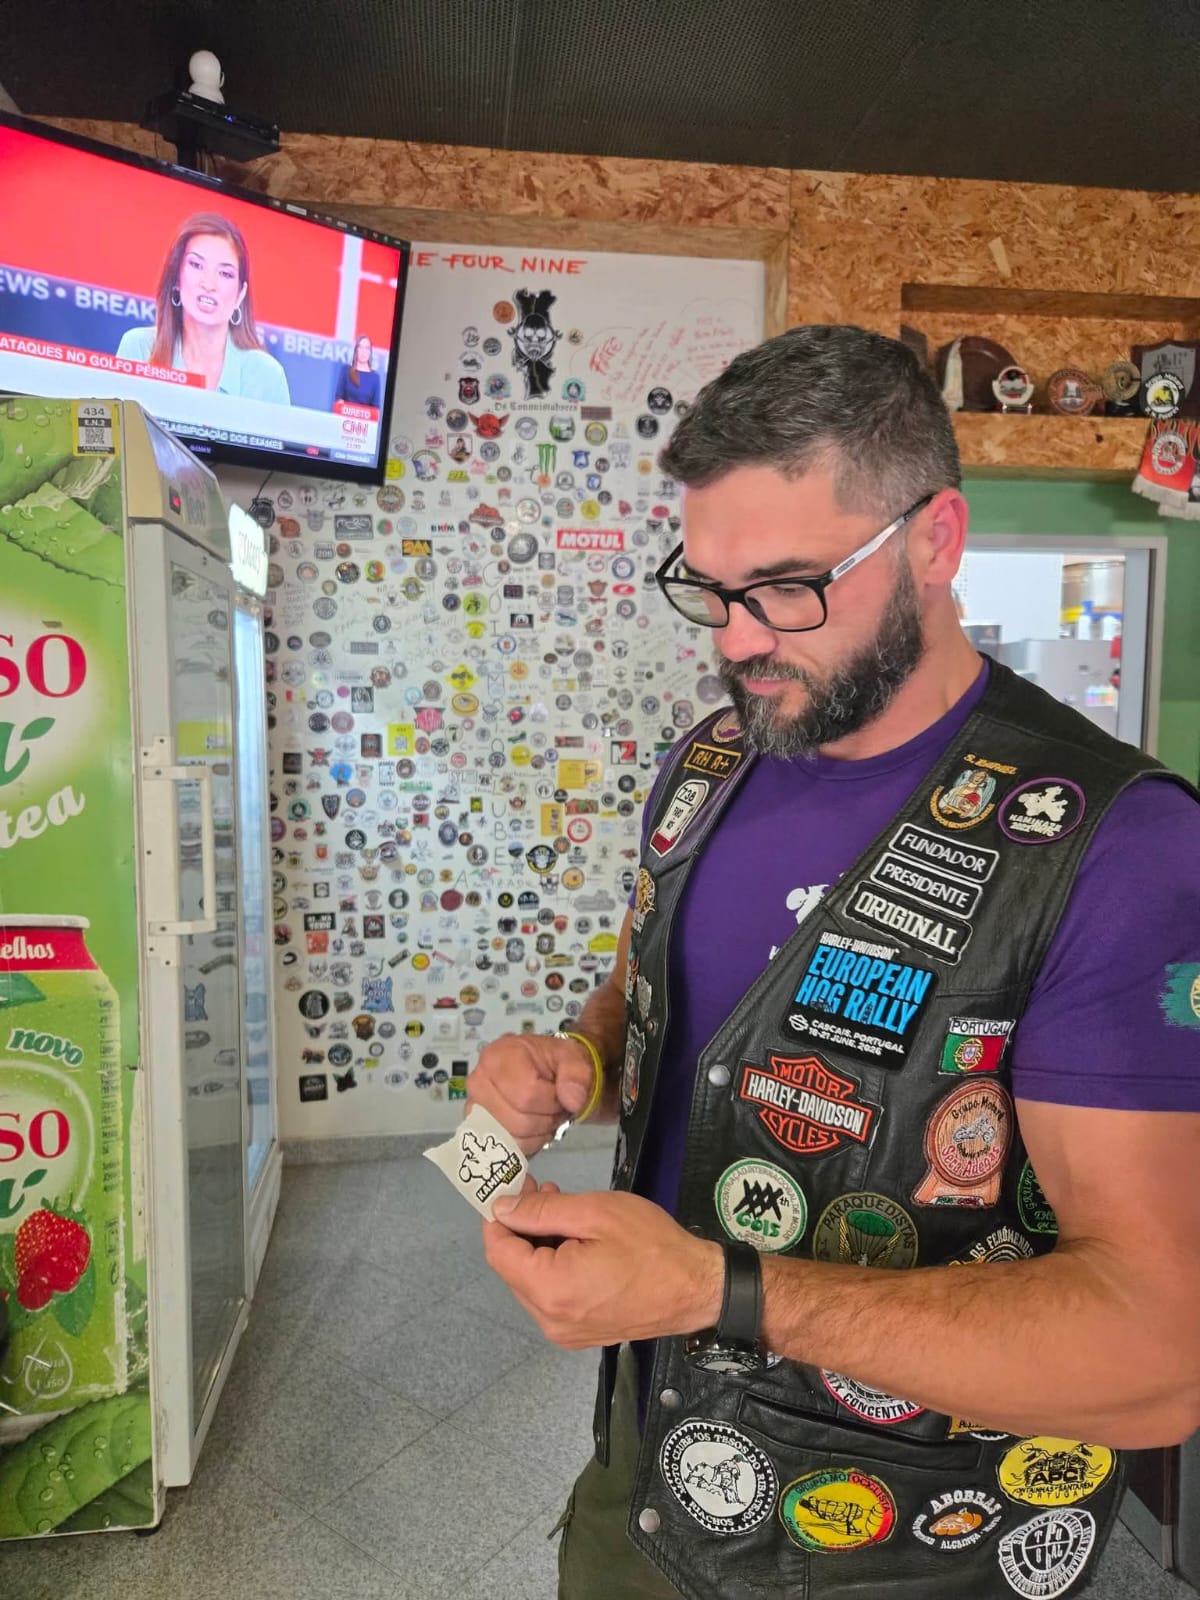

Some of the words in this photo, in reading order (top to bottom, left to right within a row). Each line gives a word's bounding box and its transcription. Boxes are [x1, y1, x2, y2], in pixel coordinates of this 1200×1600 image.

[442, 253, 514, 272] FOUR
[521, 255, 588, 274] NINE
[75, 285, 157, 322] BREAK
[0, 337, 63, 359] ATAQUES
[66, 350, 86, 363] NO
[89, 355, 133, 373] GOLFO
[136, 363, 187, 384] PÉRSICO
[83, 408, 105, 416] 434
[342, 420, 368, 437] CNN
[561, 532, 622, 548] MOTUL
[901, 833, 986, 873] FUNDADOR
[881, 863, 970, 908] PRESIDENTE
[854, 891, 957, 955] ORIGINAL
[820, 932, 896, 960] HARLEY-DAVIDSON
[808, 944, 933, 1004] EUROPEAN
[795, 975, 846, 1014] HOG
[843, 989, 918, 1035] RALLY
[952, 1021, 1010, 1035] PORTUGAL
[9, 1030, 83, 1065] novo
[853, 1032, 905, 1054] PORTUGAL
[857, 1042, 882, 1056] 2026
[780, 1063, 841, 1098] MOTOR
[747, 1073, 865, 1135] HARLEY-DAVIDSON
[951, 1100, 980, 1119] Grupo
[769, 1113, 829, 1147] CYCLES
[477, 1154, 519, 1201] KAMIKAZE
[823, 1197, 915, 1249] PARAQUEDISTAS
[969, 1242, 986, 1258] OS
[825, 1372, 844, 1392] XIX
[843, 1392, 916, 1419] CONCENTRA
[672, 1435, 694, 1460] CLUBE
[713, 1434, 749, 1454] TESOS
[748, 1453, 761, 1470] DO
[671, 1463, 687, 1494] MOTO
[795, 1475, 828, 1494] GRUPO
[689, 1501, 734, 1526] RIACHOS
